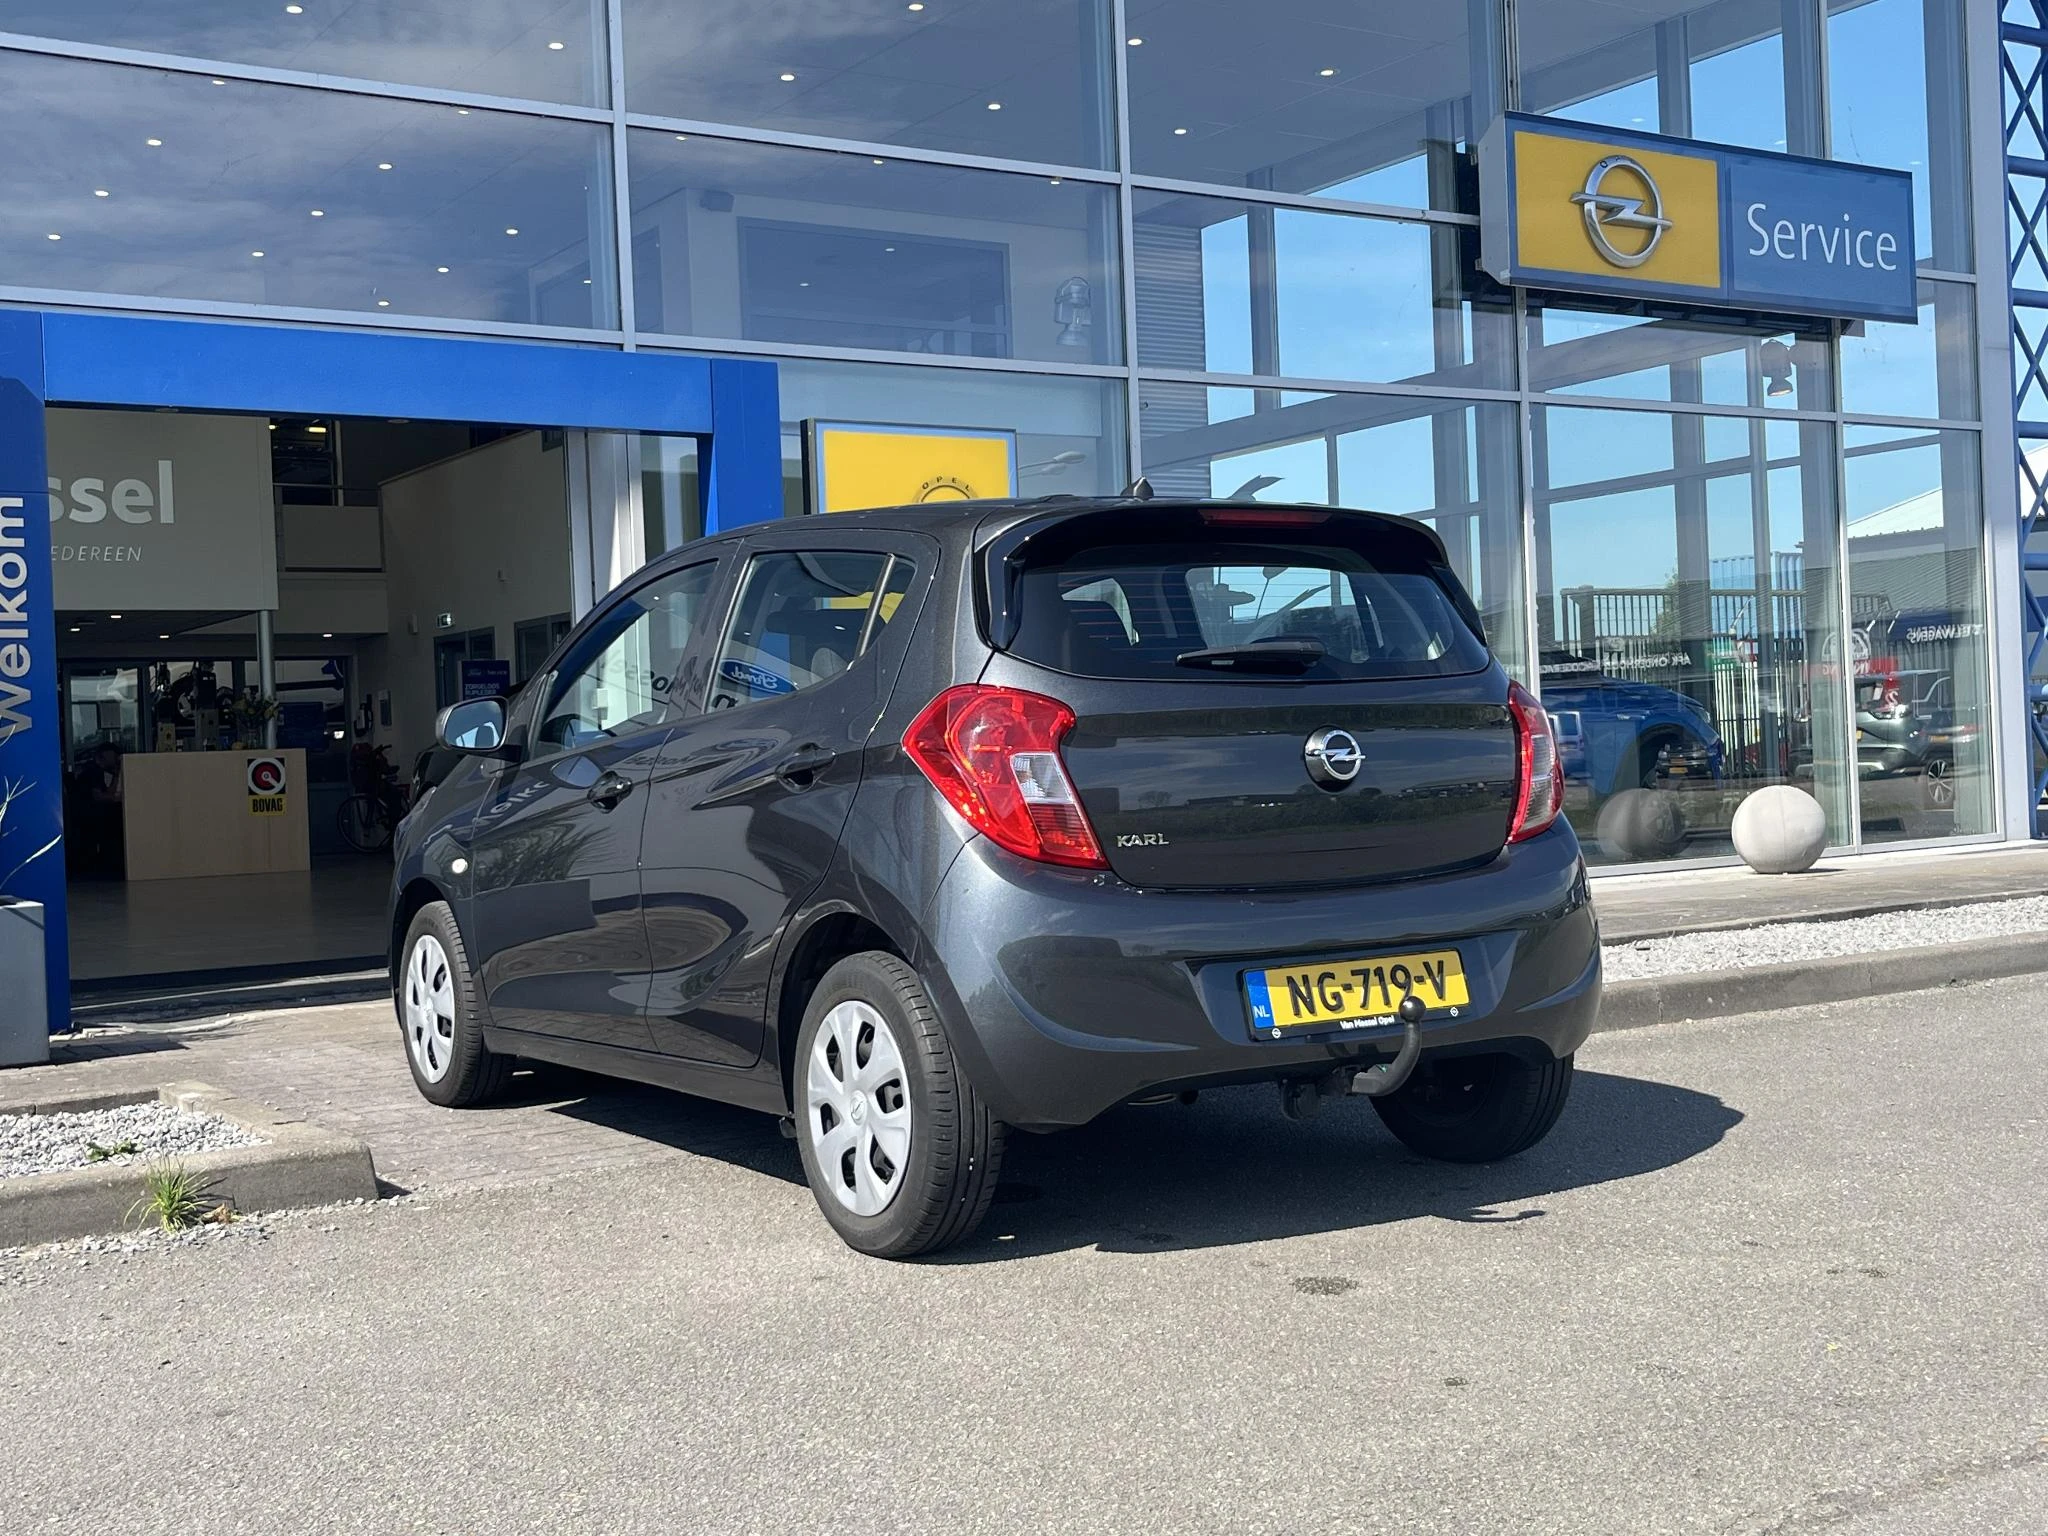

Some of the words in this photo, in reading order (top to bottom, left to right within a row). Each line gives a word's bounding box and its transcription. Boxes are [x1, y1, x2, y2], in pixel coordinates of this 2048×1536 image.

[1747, 202, 1898, 272] Service
[921, 475, 971, 493] OPEL
[0, 496, 33, 746] Welkom
[252, 798, 283, 813] BOVAG
[1117, 832, 1170, 848] KARL
[1286, 959, 1446, 1019] NG-719-V
[1253, 1005, 1271, 1019] NL
[1339, 1020, 1355, 1030] Van
[1378, 1014, 1395, 1026] Opel
